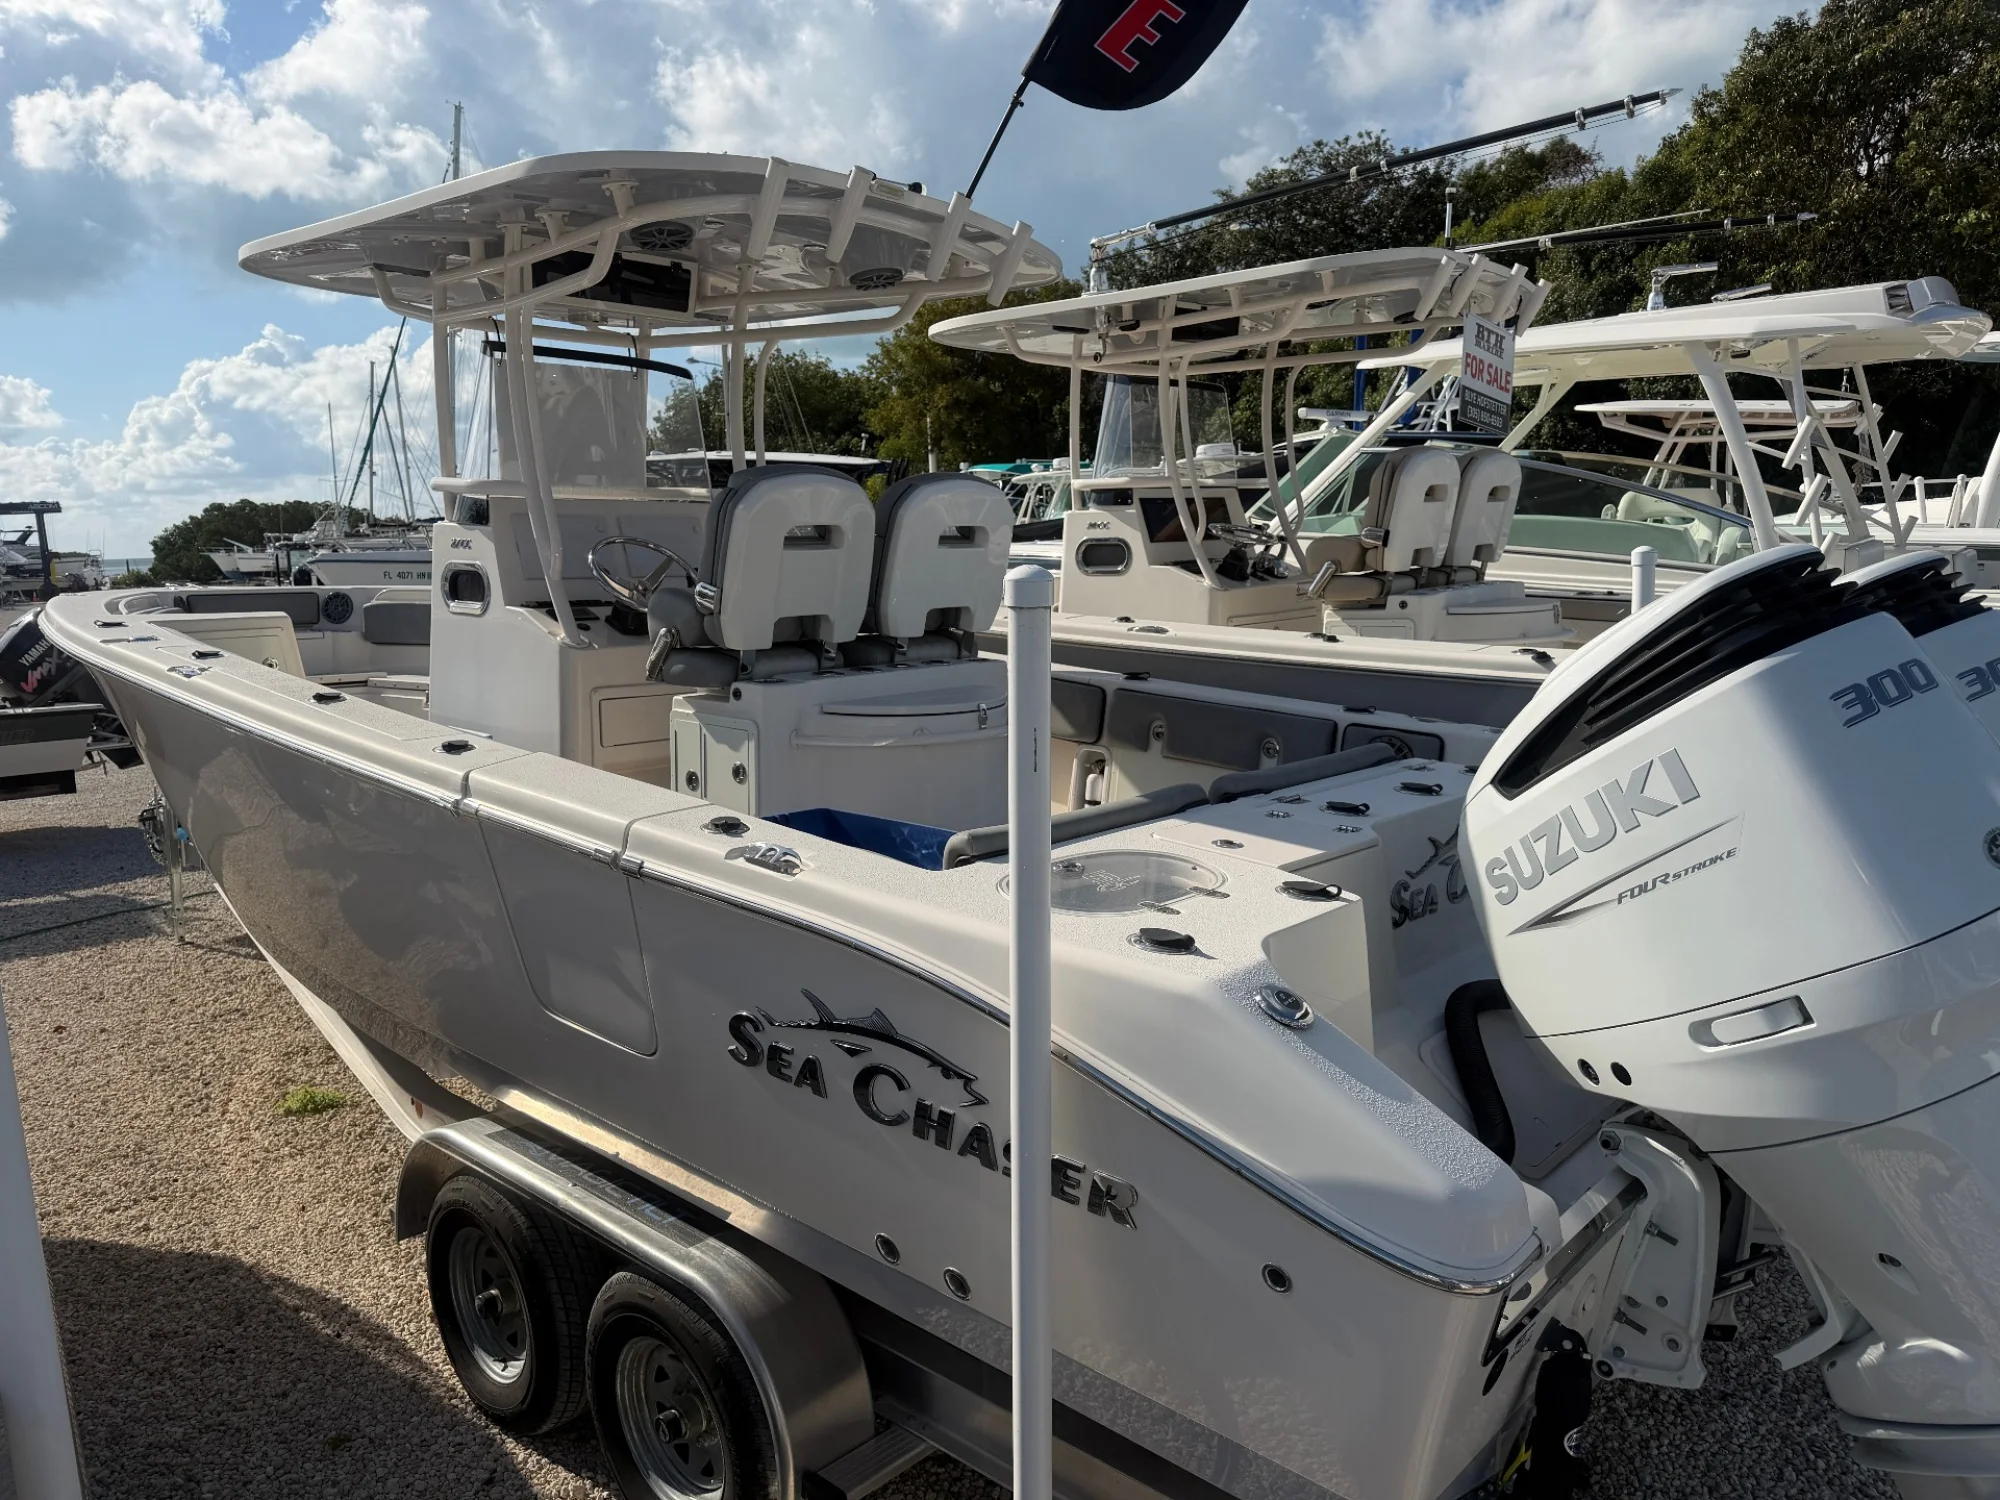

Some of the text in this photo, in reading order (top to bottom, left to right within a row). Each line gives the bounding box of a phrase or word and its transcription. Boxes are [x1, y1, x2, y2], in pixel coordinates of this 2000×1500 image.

[1475, 323, 1505, 351] BTH
[1475, 339, 1504, 359] MARINE
[1465, 352, 1511, 393] FOR SALE
[383, 571, 393, 580] FL
[396, 571, 414, 580] 4071
[19, 637, 53, 667] YAMAH
[1829, 658, 1939, 728] 300
[1485, 747, 1701, 906] SUZUKI
[1617, 847, 1738, 905] FOUR STROKE
[1390, 879, 1439, 930] SEA
[727, 1010, 828, 1099] SEA
